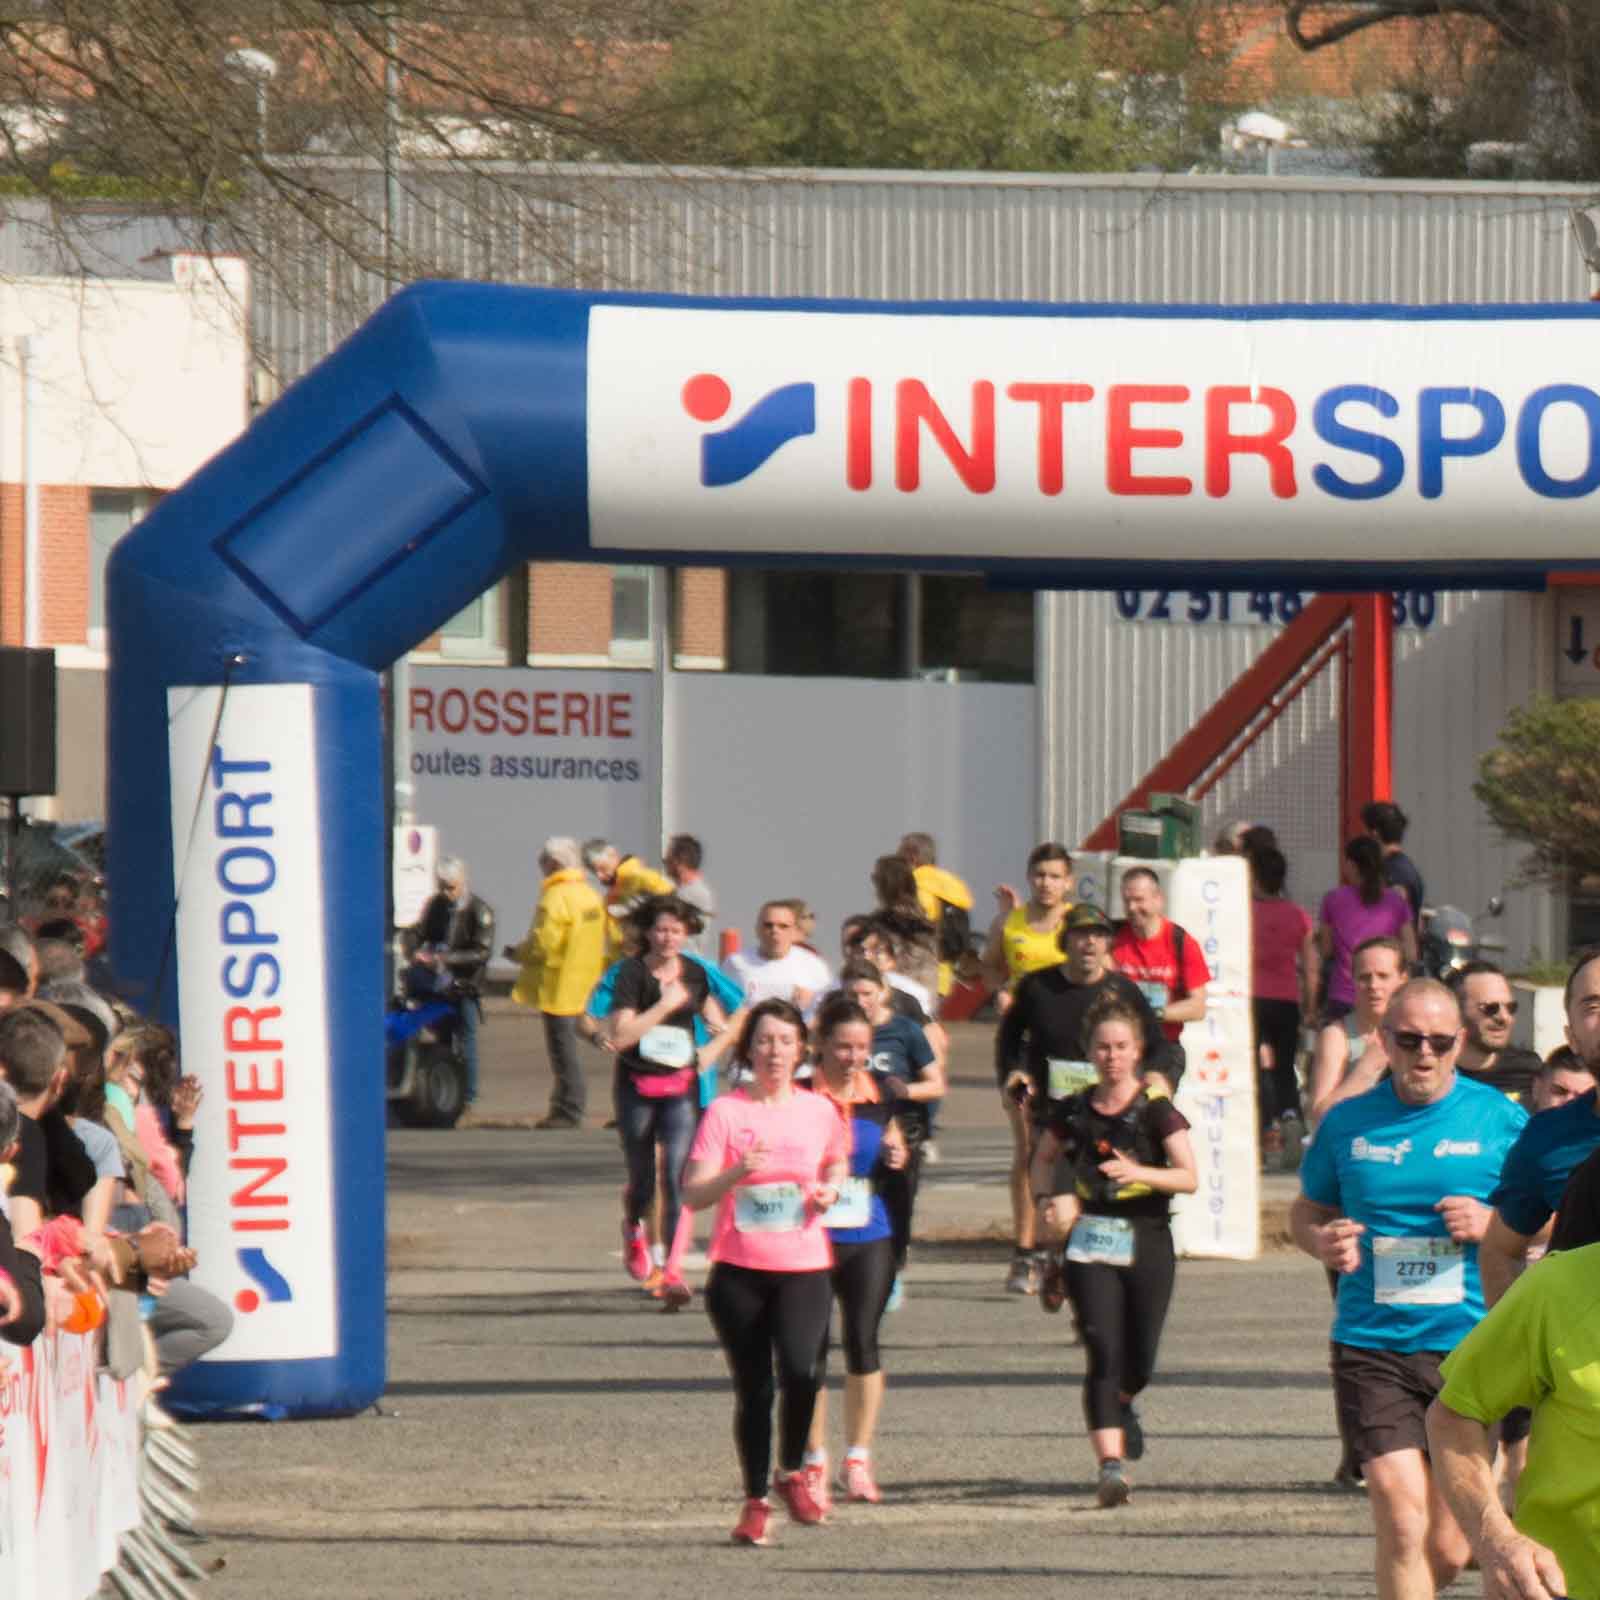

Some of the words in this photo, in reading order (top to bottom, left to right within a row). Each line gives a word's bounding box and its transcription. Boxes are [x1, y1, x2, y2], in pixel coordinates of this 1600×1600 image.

[489, 752, 641, 782] assurances
[208, 743, 291, 1233] INTERSPORT
[1396, 1260, 1437, 1277] 2779
